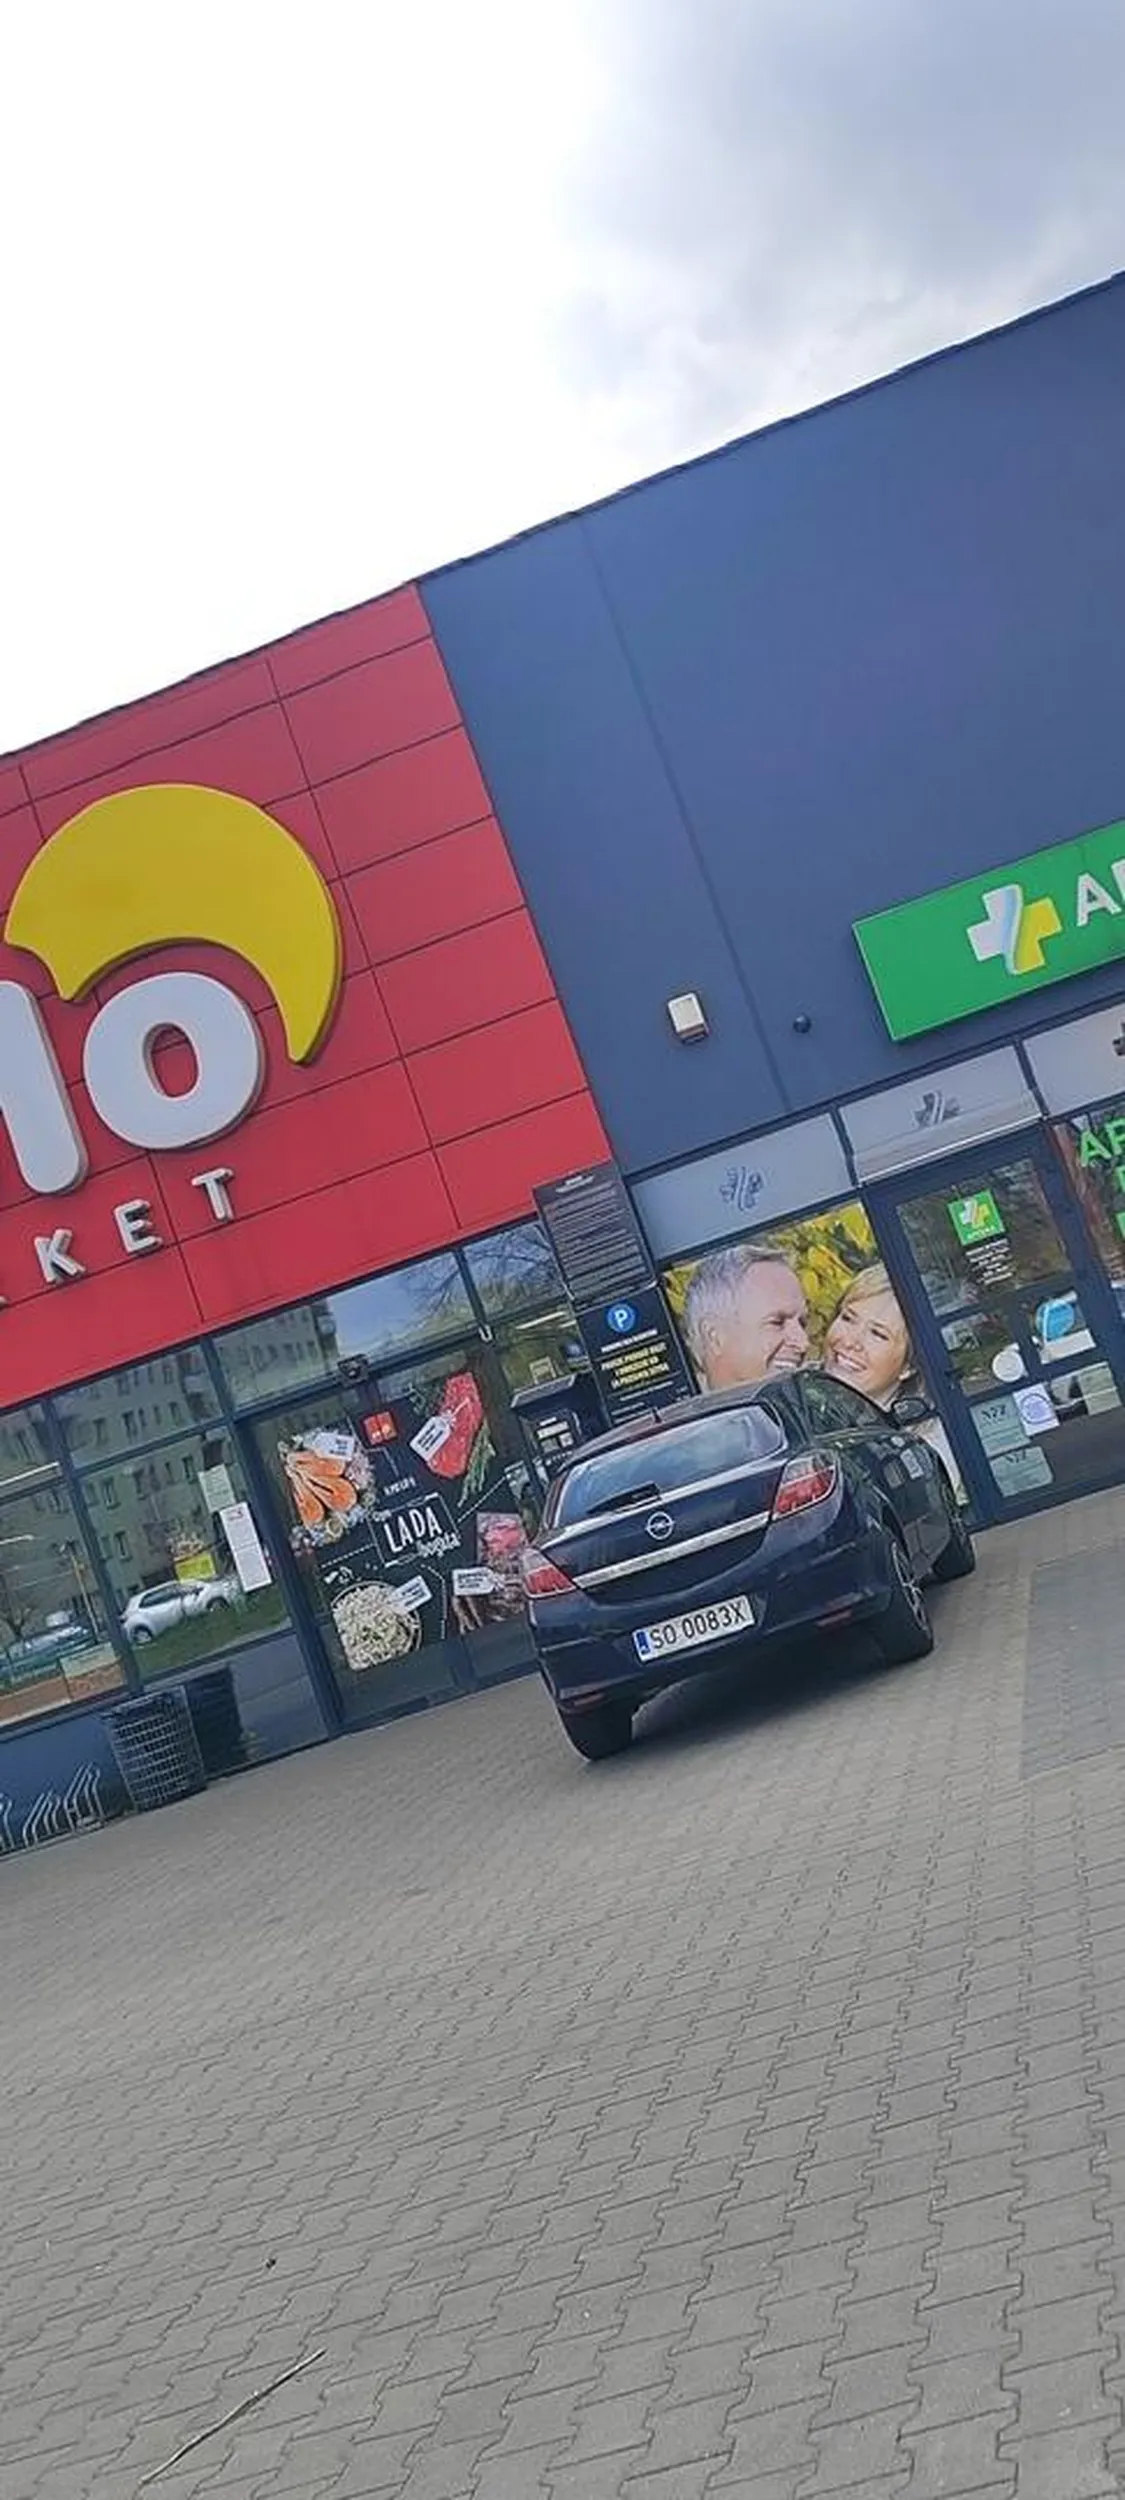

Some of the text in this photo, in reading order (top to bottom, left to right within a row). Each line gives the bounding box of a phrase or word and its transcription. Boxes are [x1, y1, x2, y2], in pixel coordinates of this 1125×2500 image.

[0, 1166, 235, 1304] KET
[383, 1506, 443, 1554] LADA
[649, 1624, 678, 1650] SO
[681, 1600, 747, 1640] 0083X
